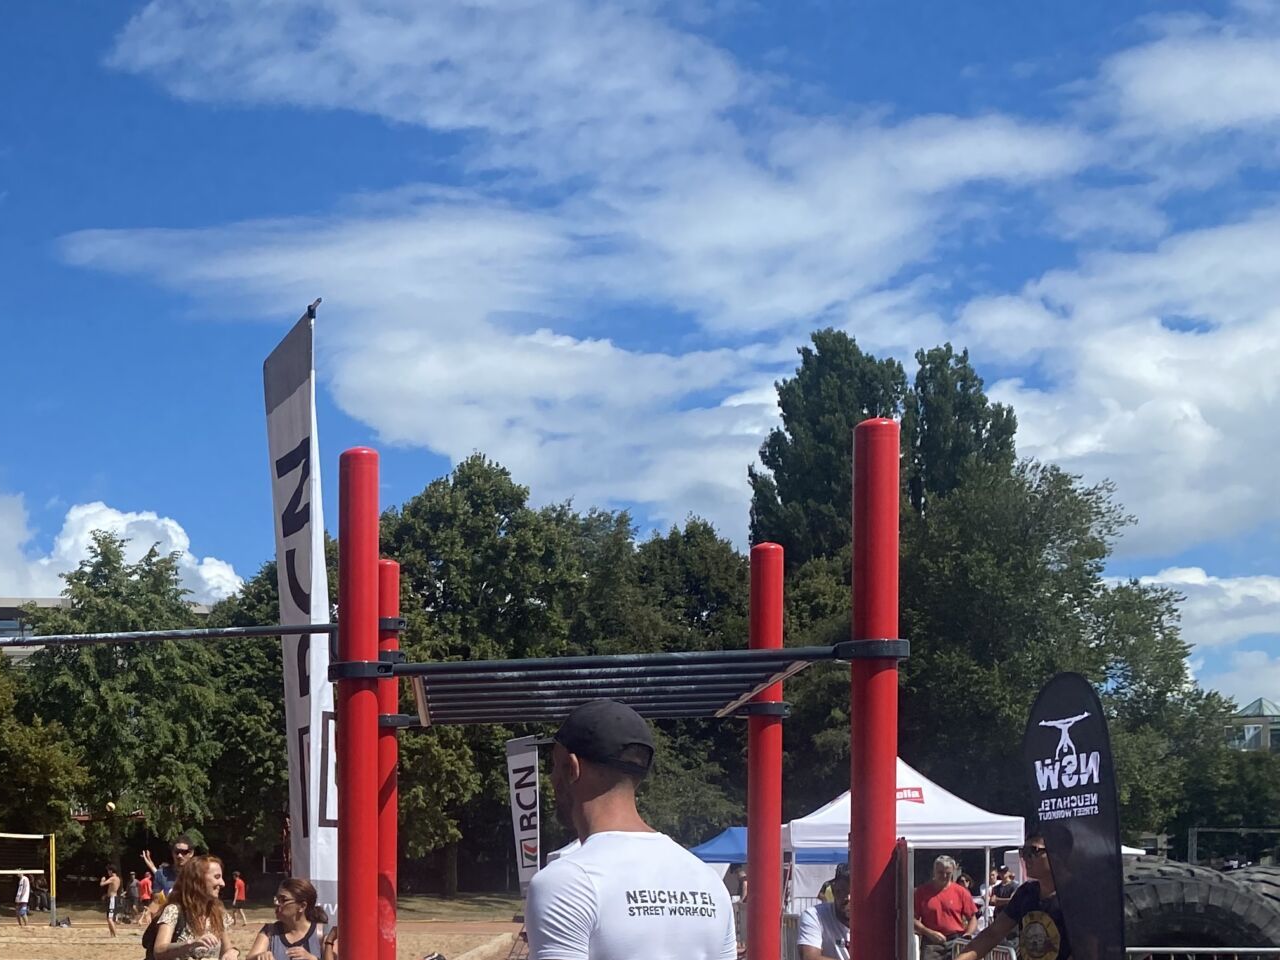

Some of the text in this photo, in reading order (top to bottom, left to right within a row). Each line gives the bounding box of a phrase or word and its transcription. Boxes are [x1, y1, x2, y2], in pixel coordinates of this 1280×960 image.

[512, 764, 537, 832] BCN
[625, 890, 716, 906] NEUCHATEL
[628, 905, 716, 918] STREET WORKOUT
